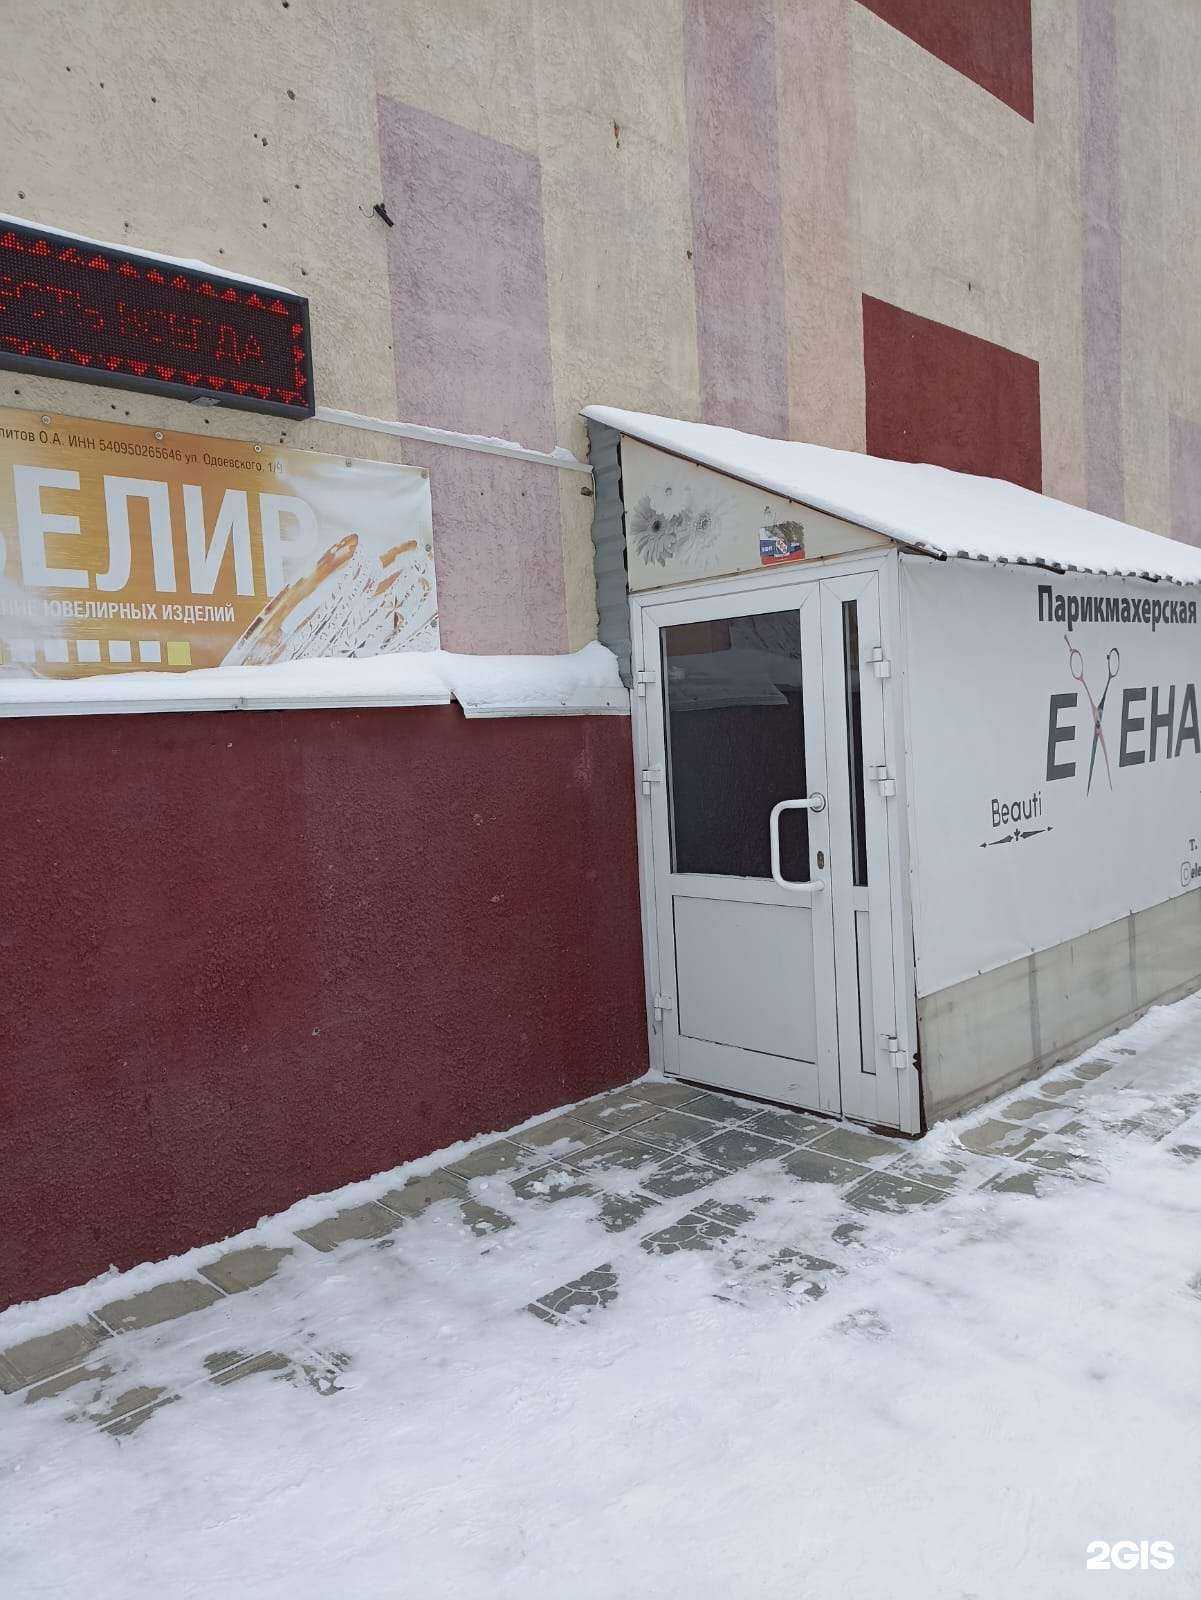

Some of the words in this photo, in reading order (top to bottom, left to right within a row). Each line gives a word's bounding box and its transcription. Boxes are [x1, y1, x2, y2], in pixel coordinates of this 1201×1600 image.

[39, 430, 65, 446] О.А.
[69, 434, 96, 450] ИНН
[99, 440, 182, 461] 540950265646
[0, 463, 319, 598] ЕЛИР
[44, 600, 157, 621] ЮВЕЛИРНЫХ
[162, 602, 235, 625] ИЗДЕЛИЙ
[1037, 584, 1198, 632] Парикмахерская
[991, 791, 1042, 828] Beauti
